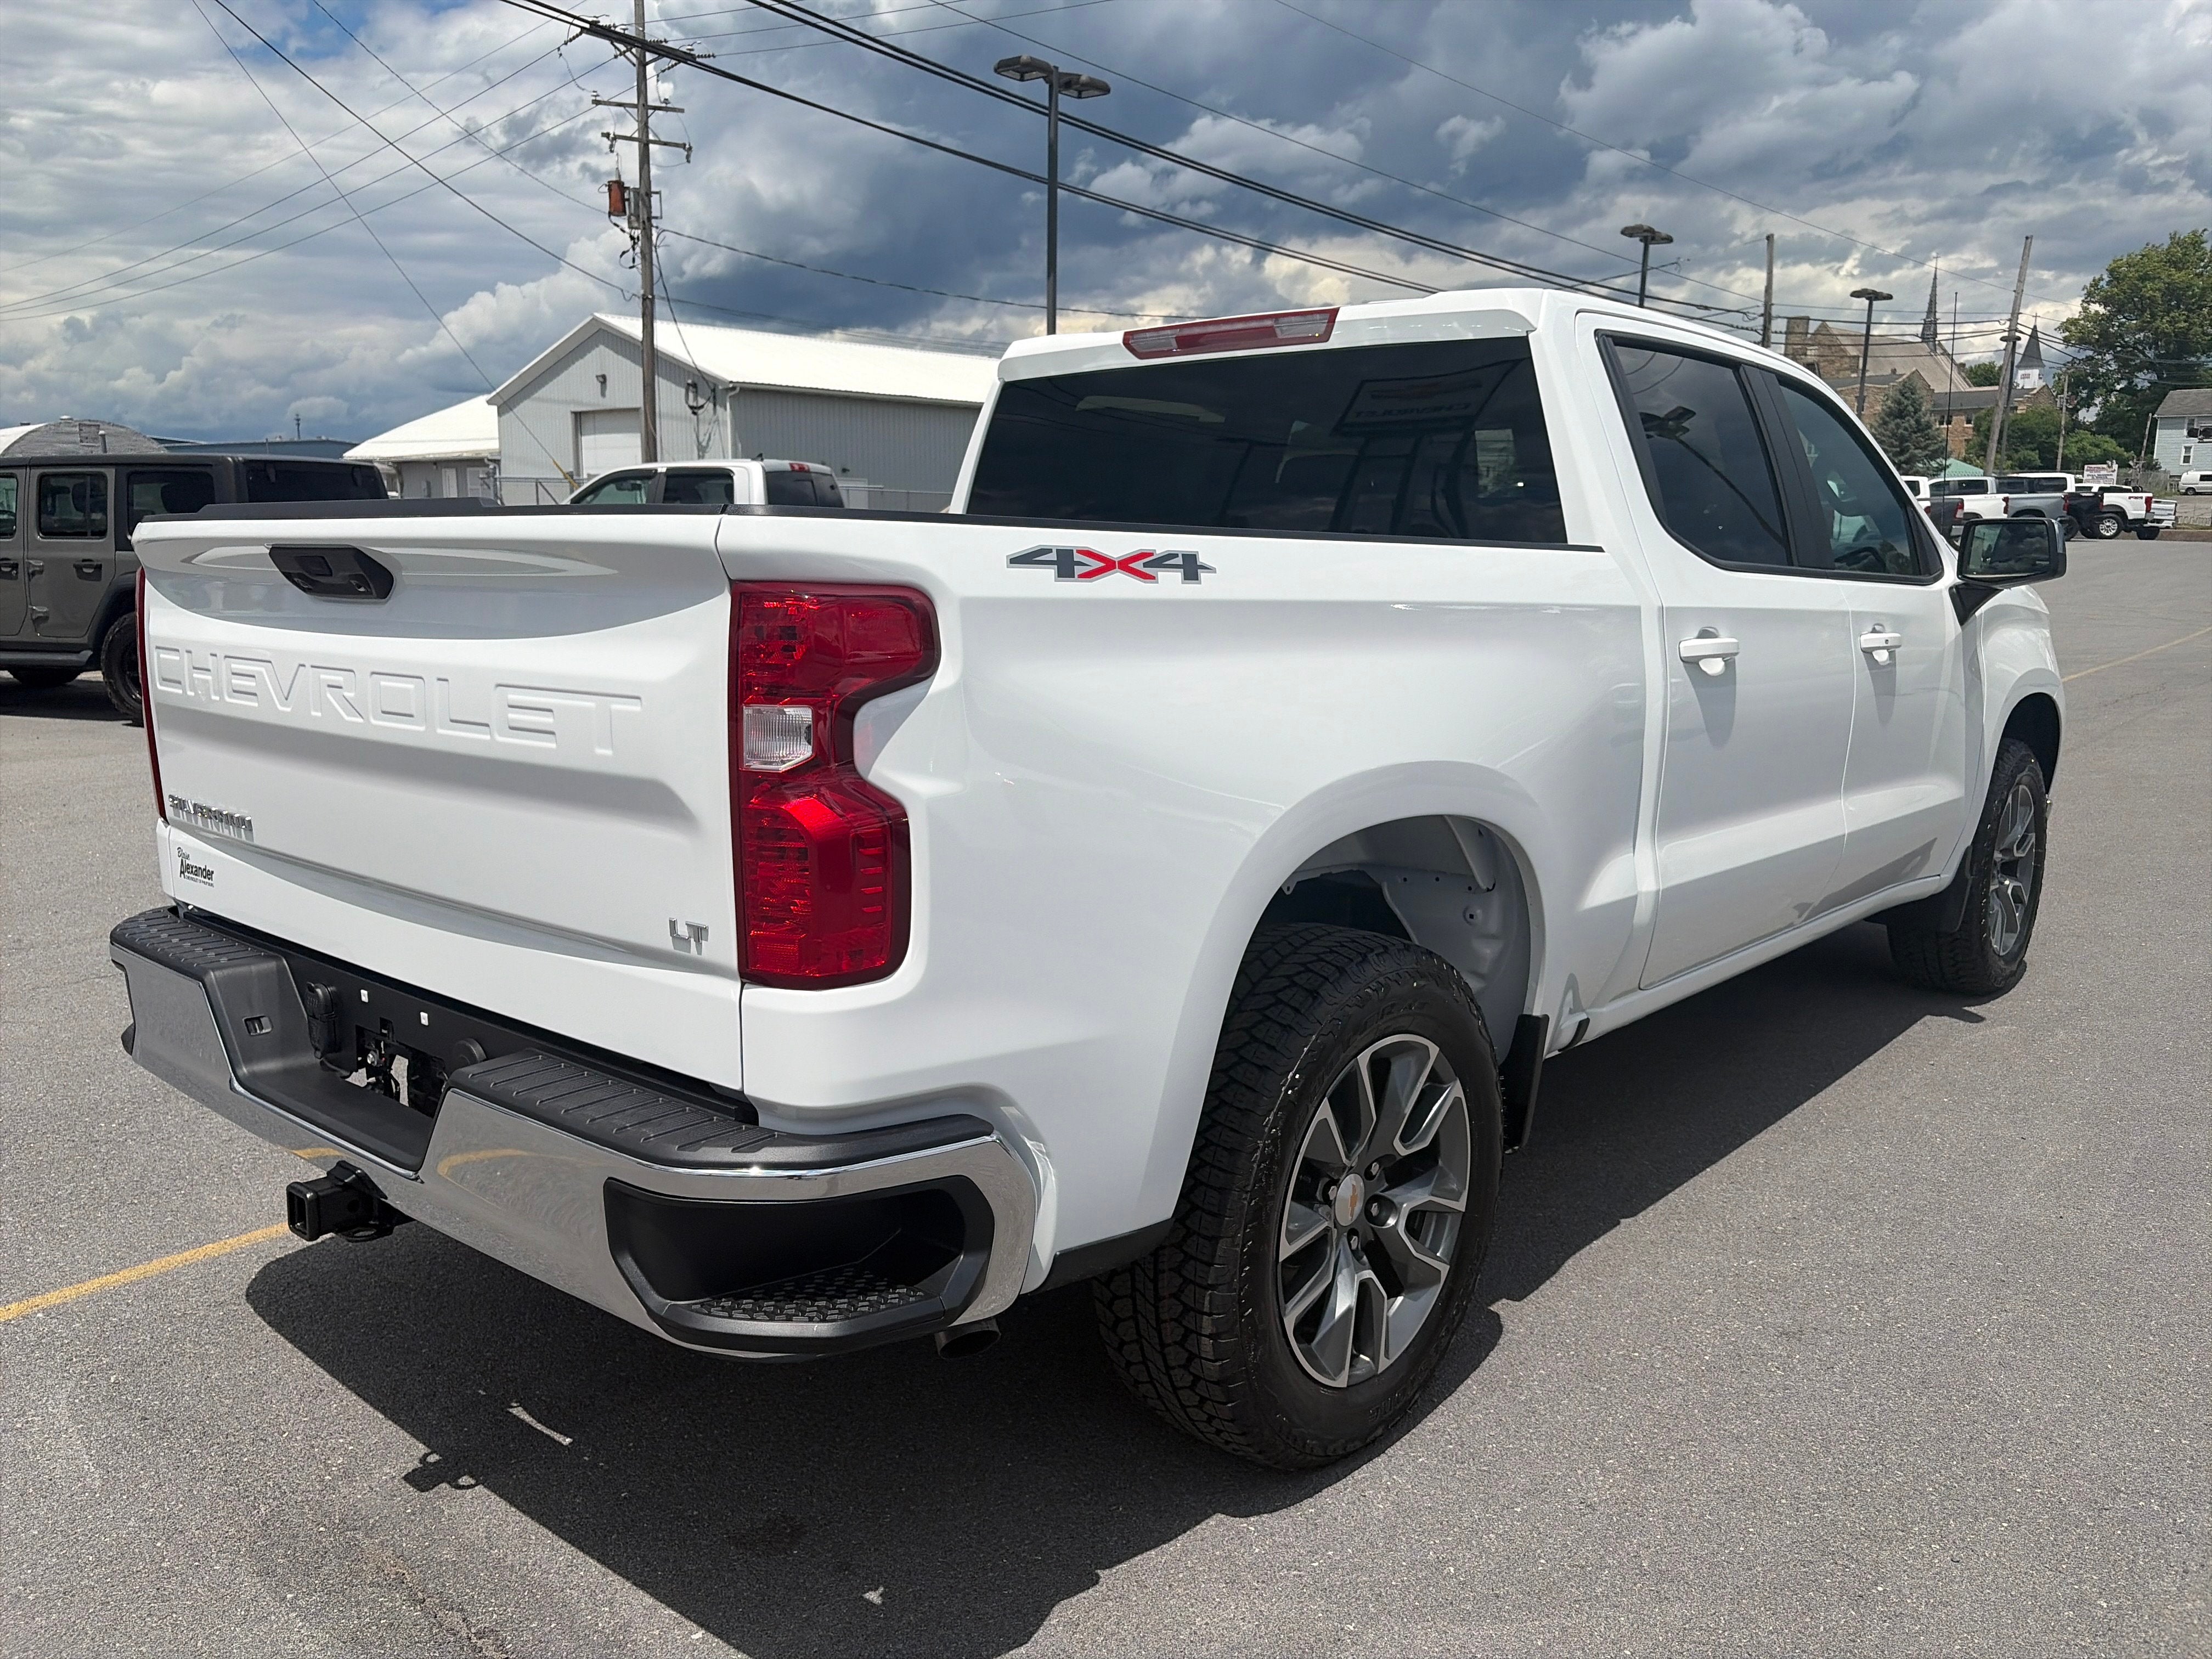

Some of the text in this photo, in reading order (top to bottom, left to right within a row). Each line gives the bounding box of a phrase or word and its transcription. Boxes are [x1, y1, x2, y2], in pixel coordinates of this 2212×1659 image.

[155, 646, 643, 756] CHEVROLET
[179, 859, 214, 881] Alexander
[668, 917, 709, 944] LT
